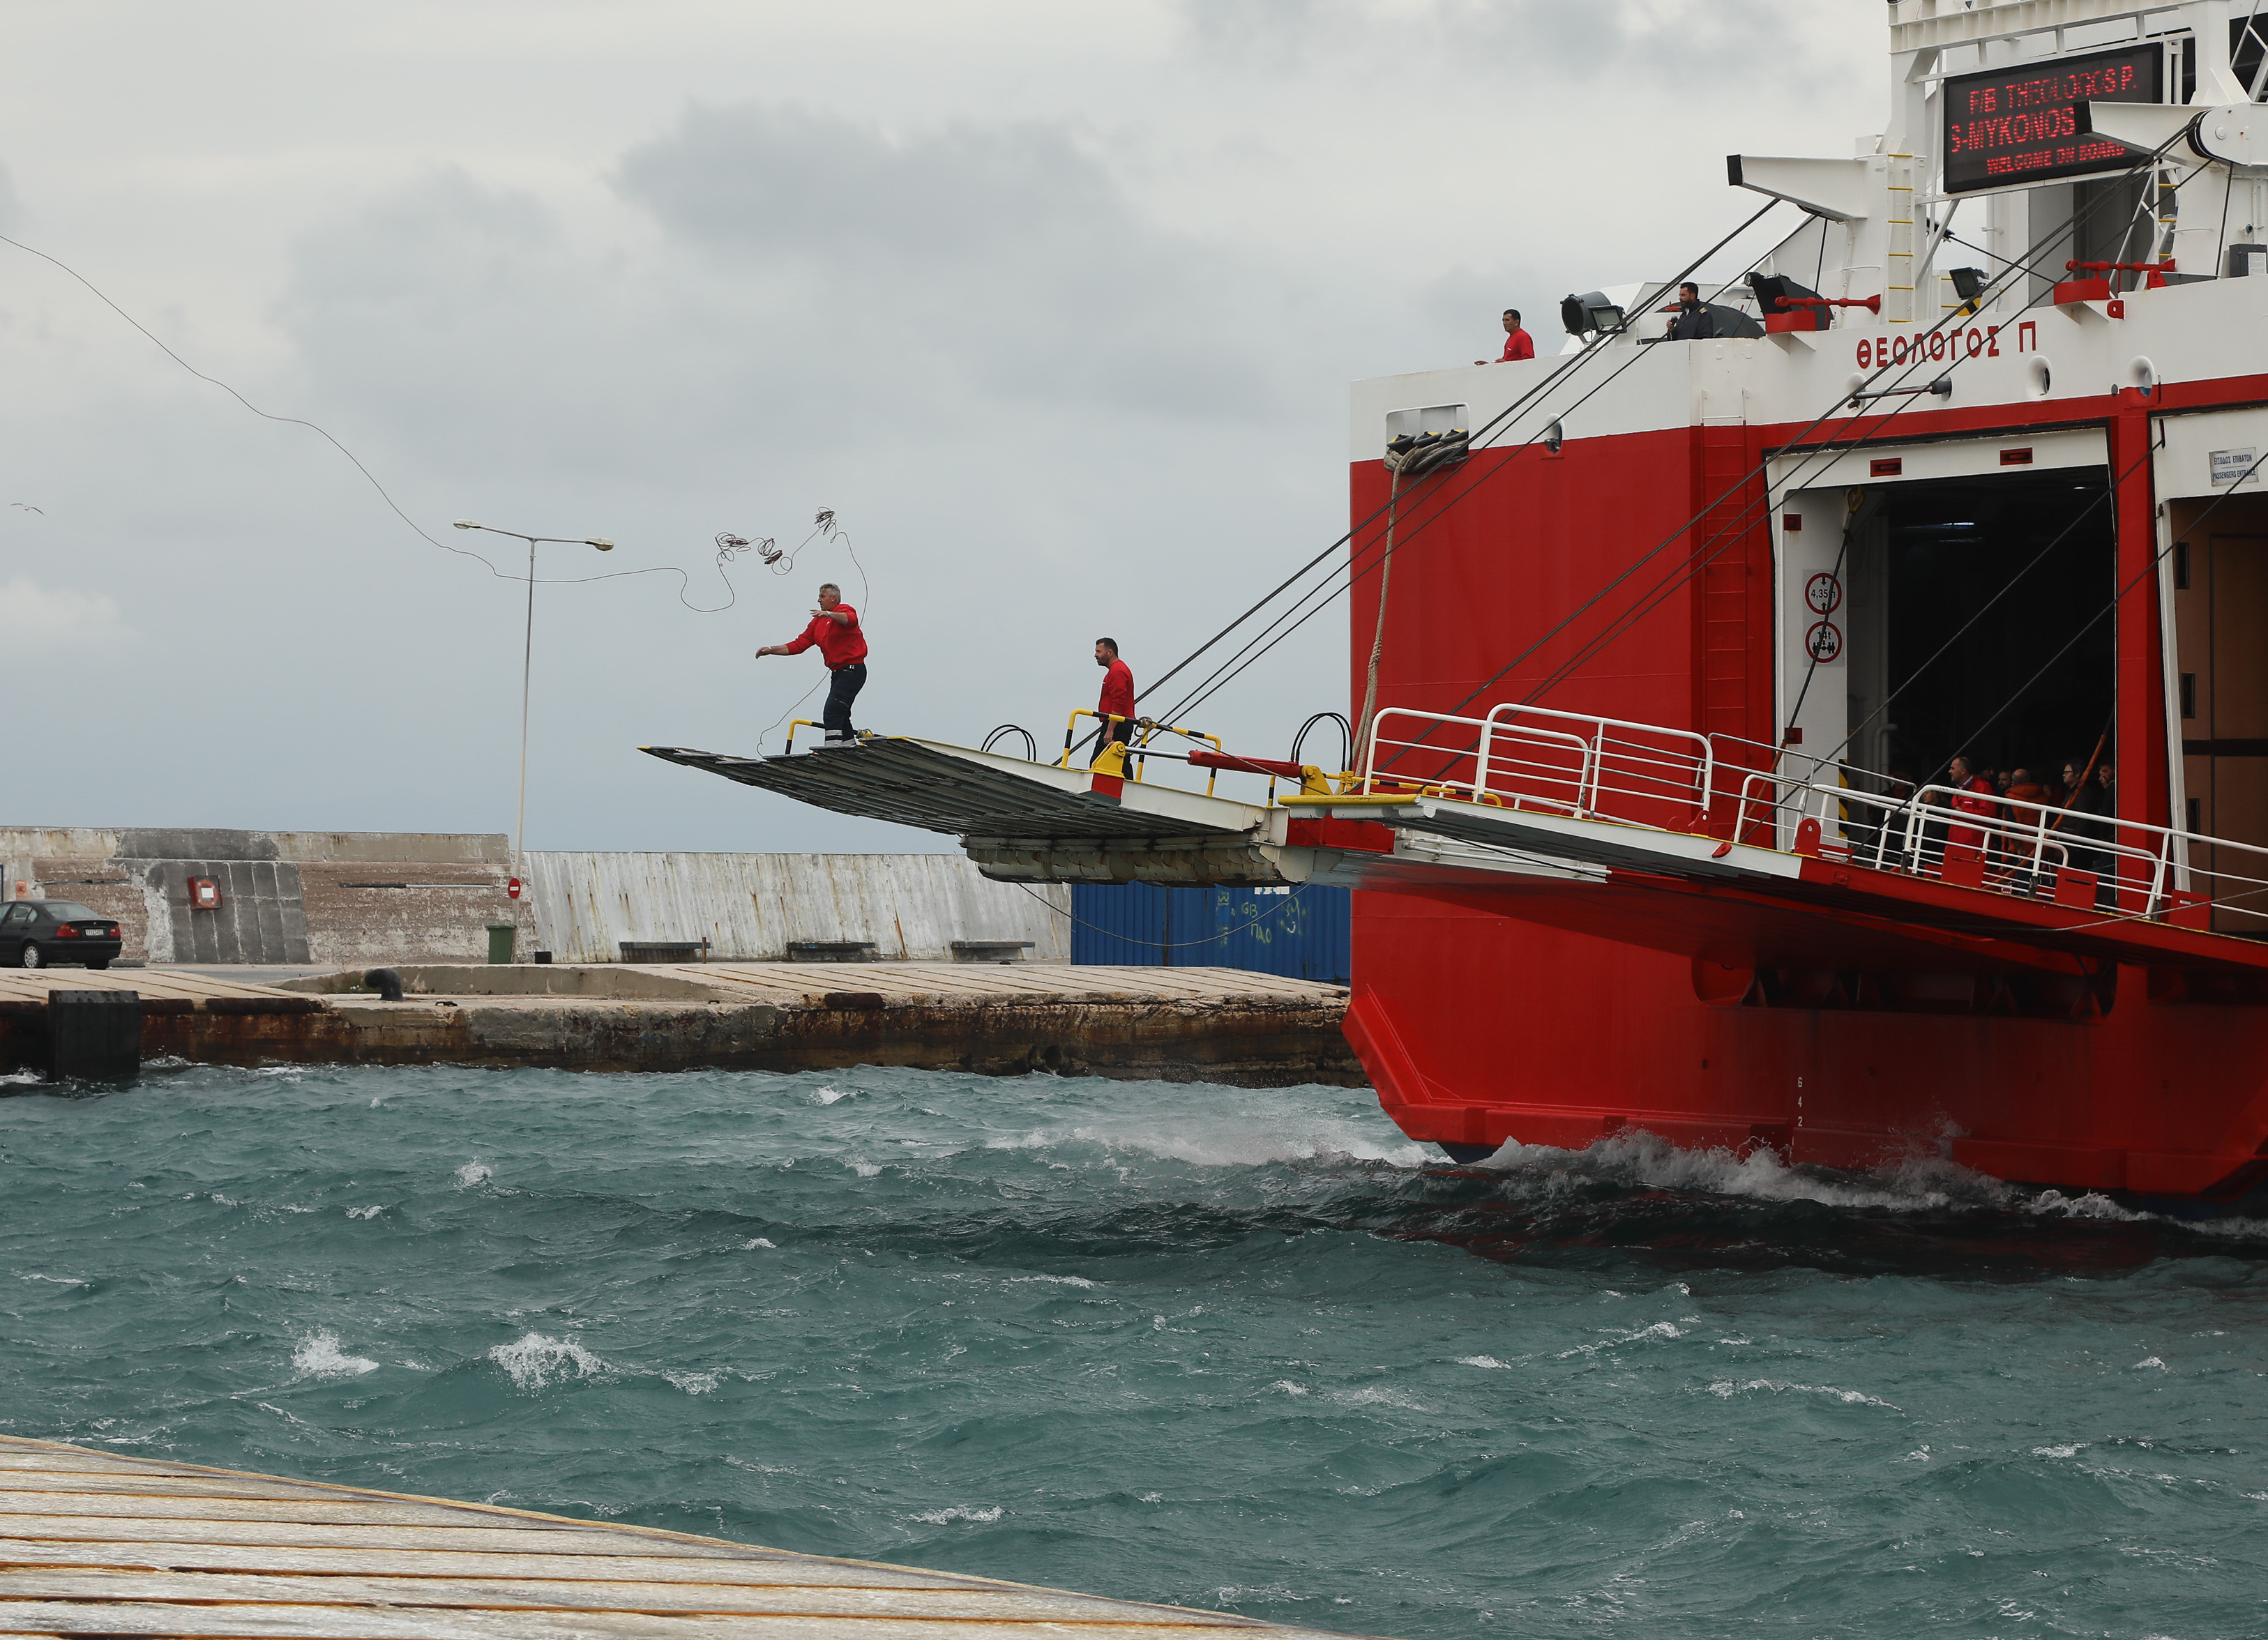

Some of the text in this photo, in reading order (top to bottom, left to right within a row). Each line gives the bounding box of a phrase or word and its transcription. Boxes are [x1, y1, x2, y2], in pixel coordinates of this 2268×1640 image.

[1969, 87, 1997, 114] F/B
[2004, 67, 2117, 109] THEOLOGOS
[1986, 150, 2053, 175] WELCOME
[2056, 146, 2076, 165] ON
[1857, 320, 2036, 370] ΘΕΟΛΟΓΟΣ Π
[1797, 1077, 1803, 1088] 6
[1797, 1096, 1803, 1108] 4
[1797, 1116, 1803, 1127] 2
